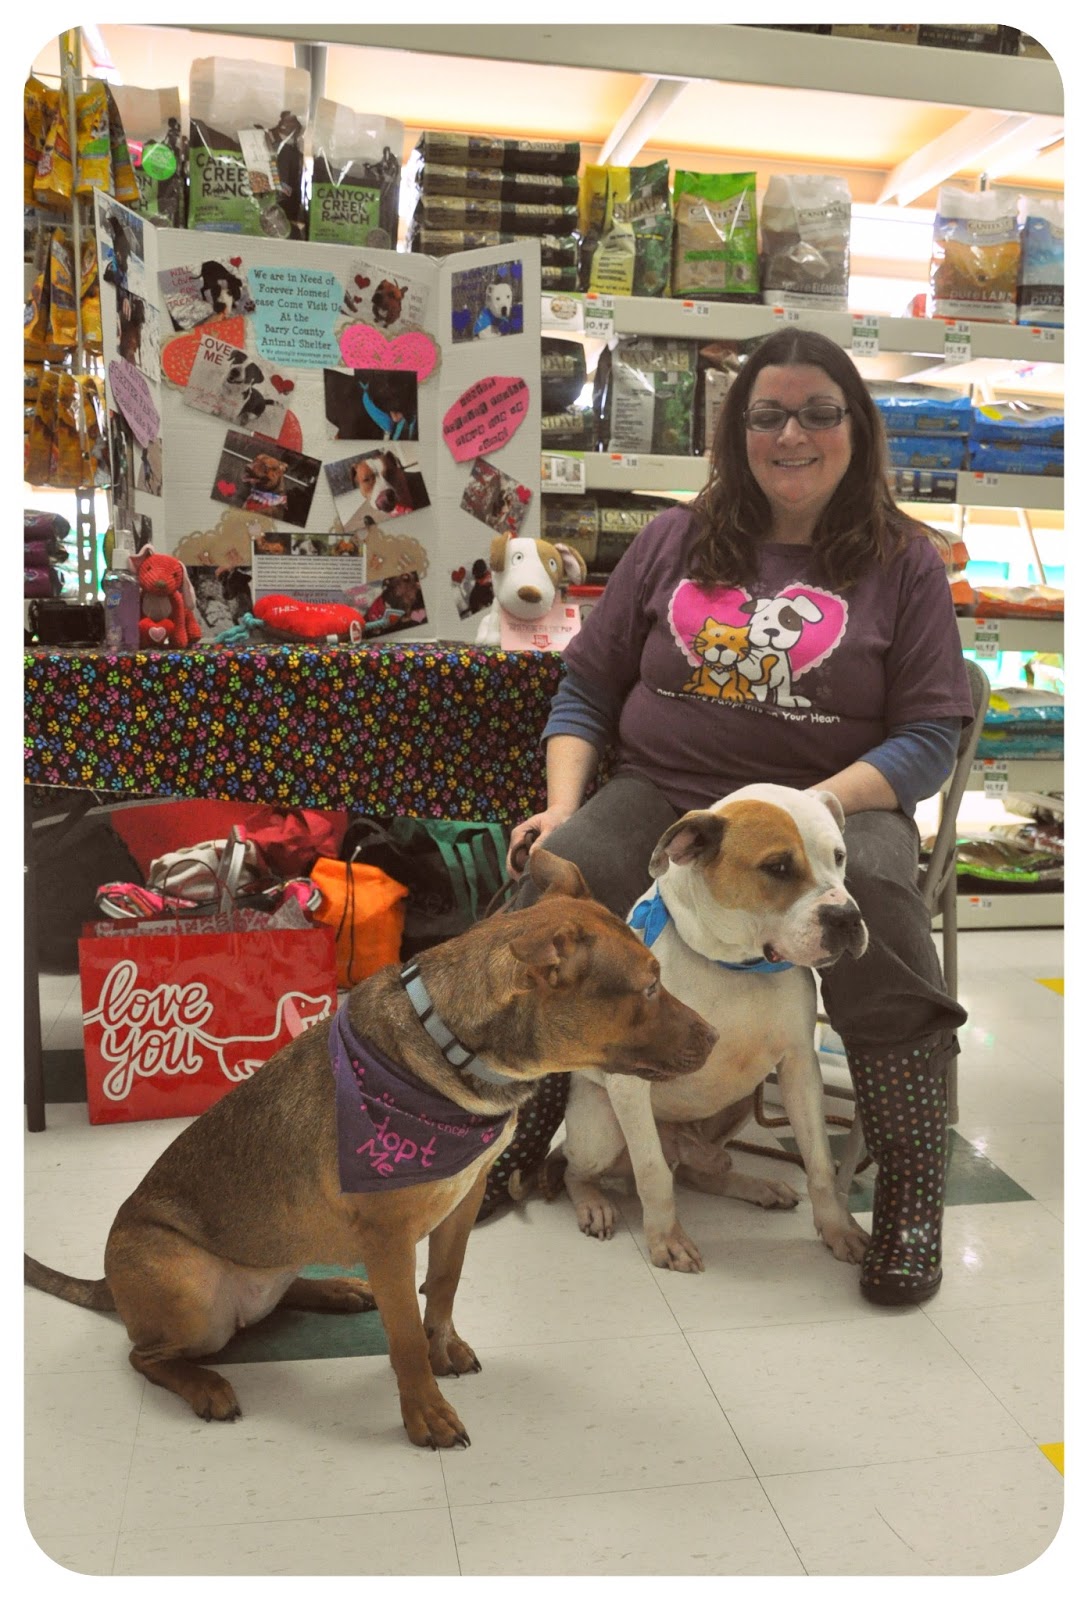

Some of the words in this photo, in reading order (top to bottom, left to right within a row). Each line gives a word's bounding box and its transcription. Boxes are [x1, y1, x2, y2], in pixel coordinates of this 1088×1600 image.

[202, 167, 248, 182] CREE
[202, 182, 251, 198] RANC
[317, 188, 375, 202] CANYON
[322, 200, 367, 214] CREEK
[321, 210, 370, 226] RANCH
[253, 269, 267, 279] We
[288, 273, 297, 282] in
[300, 273, 323, 284] Need
[325, 276, 336, 285] of
[259, 283, 294, 295] Forever
[297, 287, 330, 298] Homes!
[278, 299, 303, 308] Come
[307, 300, 328, 311] Visit
[280, 312, 291, 321] At
[294, 313, 309, 322] the
[265, 323, 290, 335] Barry
[292, 326, 325, 338] County
[261, 337, 295, 348] Animal
[299, 339, 332, 350] Shelter
[204, 350, 224, 366] ME
[604, 511, 657, 527] CANID
[782, 711, 807, 721] Your
[810, 712, 841, 724] Heart
[101, 960, 214, 1030] love
[101, 1027, 203, 1101] you
[355, 1138, 395, 1178] Me
